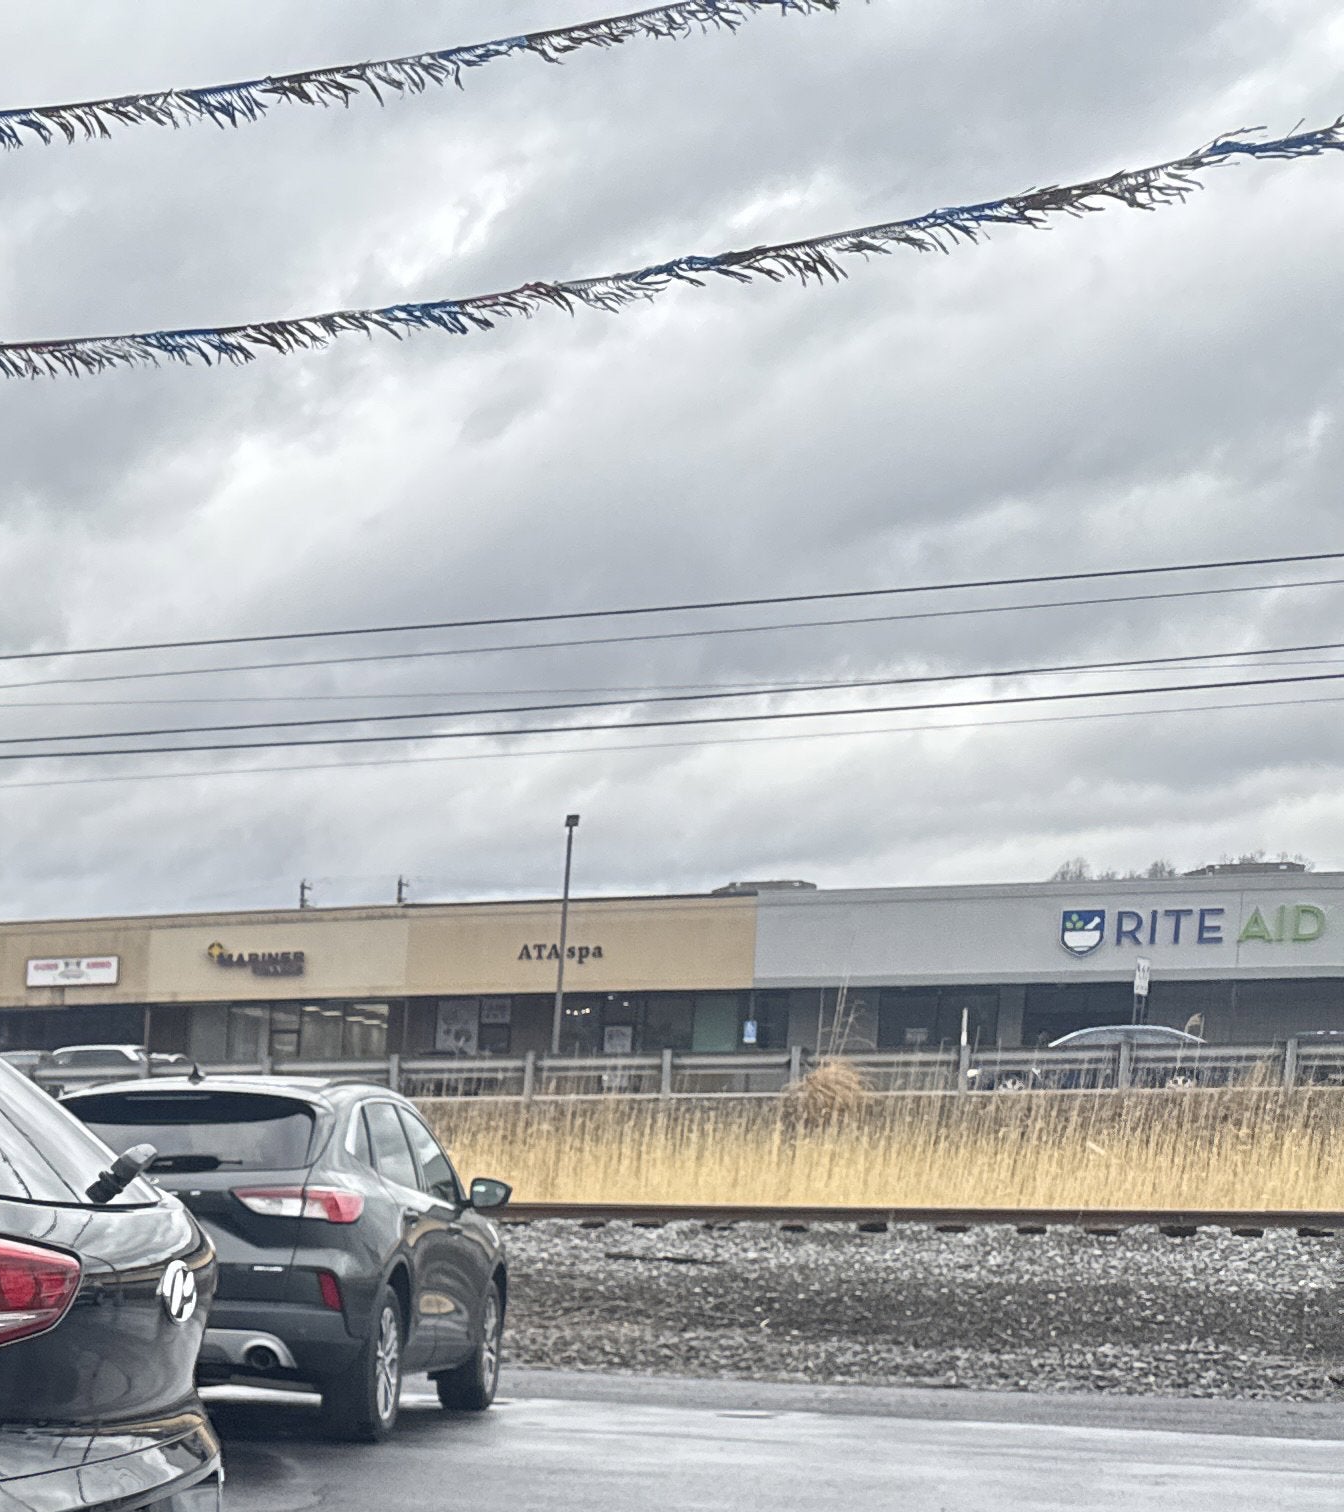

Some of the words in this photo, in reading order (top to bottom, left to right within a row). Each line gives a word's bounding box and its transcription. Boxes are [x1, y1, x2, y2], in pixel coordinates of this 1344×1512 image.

[1115, 907, 1225, 946] RITE
[1237, 904, 1327, 943] AID
[517, 943, 560, 961] ATA
[566, 945, 604, 965] spa
